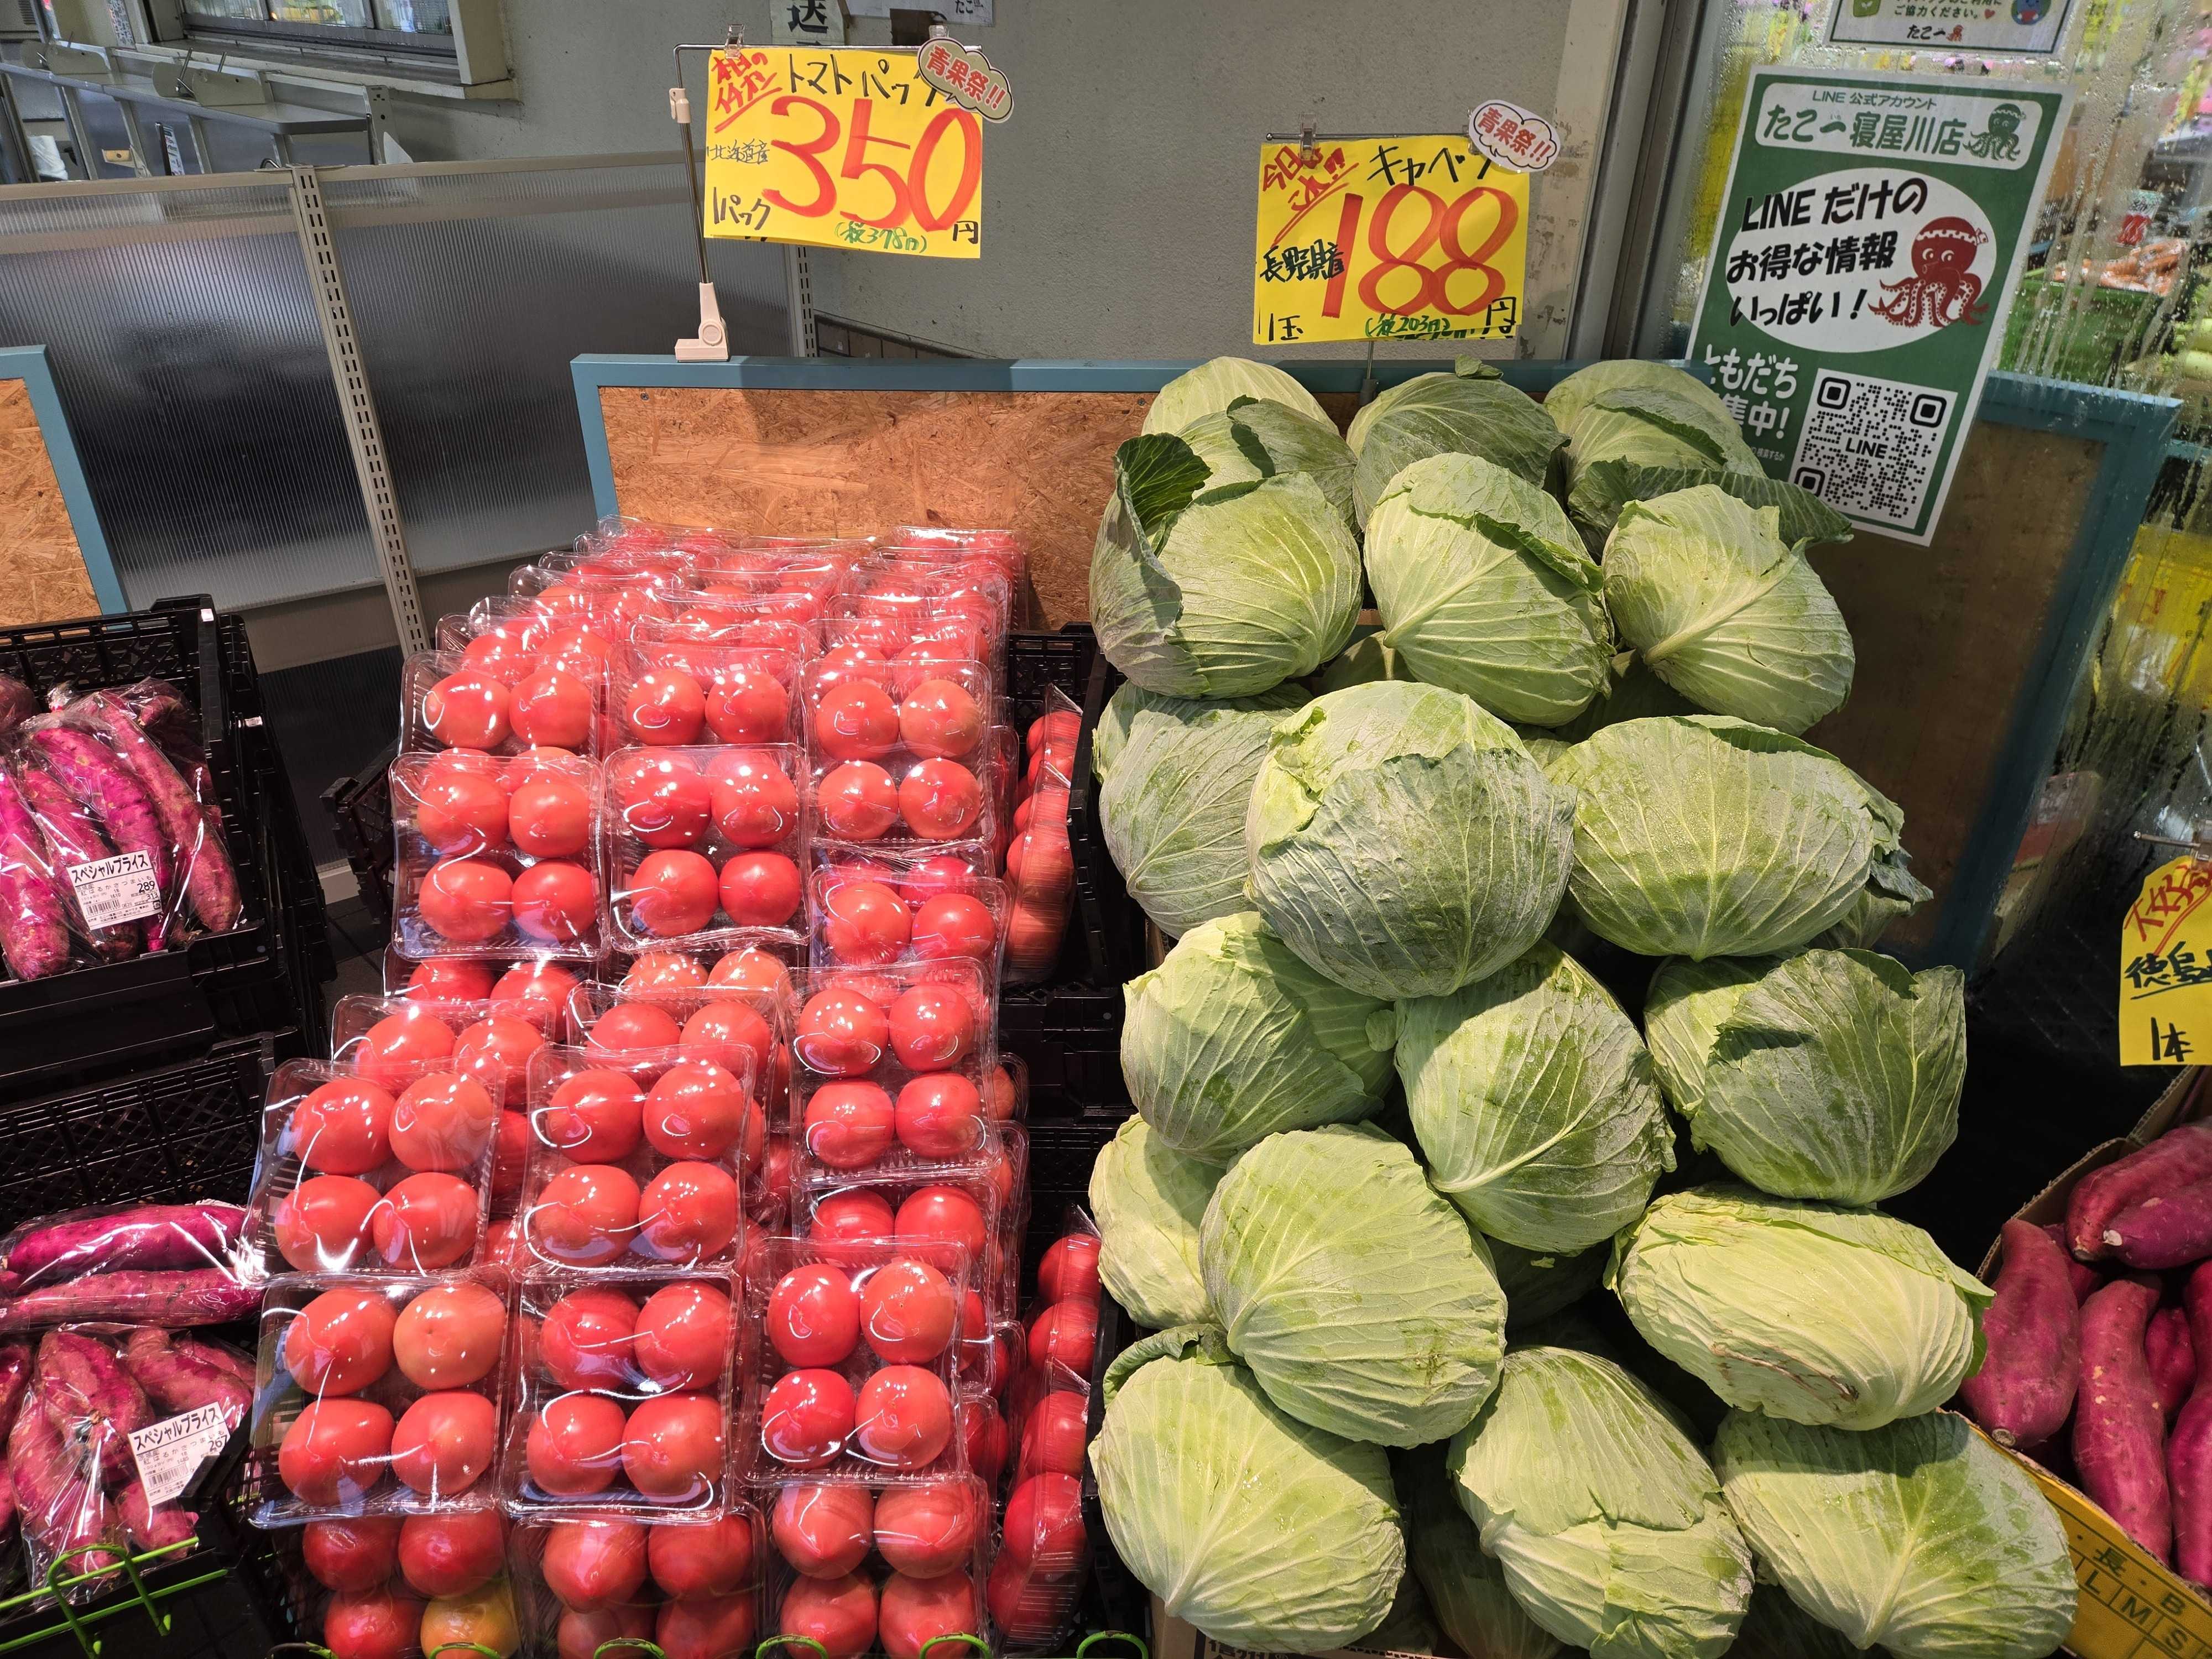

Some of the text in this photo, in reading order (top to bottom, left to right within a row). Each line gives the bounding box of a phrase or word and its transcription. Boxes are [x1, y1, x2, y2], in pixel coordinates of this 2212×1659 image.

[1812, 90, 1937, 110] LINE 公式アカウント
[762, 95, 983, 232] 350
[1366, 145, 1493, 186] キャベ
[1740, 178, 1928, 232] LINE だけの
[1321, 182, 1519, 319] 188
[1726, 230, 1898, 284] お得な情報
[1845, 438, 1888, 458] LINE
[71, 854, 148, 883] スペシャルプライス
[137, 880, 155, 893] 289
[2124, 941, 2212, 989] 徳島
[134, 1407, 220, 1451] スペシャルプライス
[2084, 1570, 2101, 1594] L
[2122, 1596, 2153, 1625] M
[2164, 1627, 2188, 1650] S
